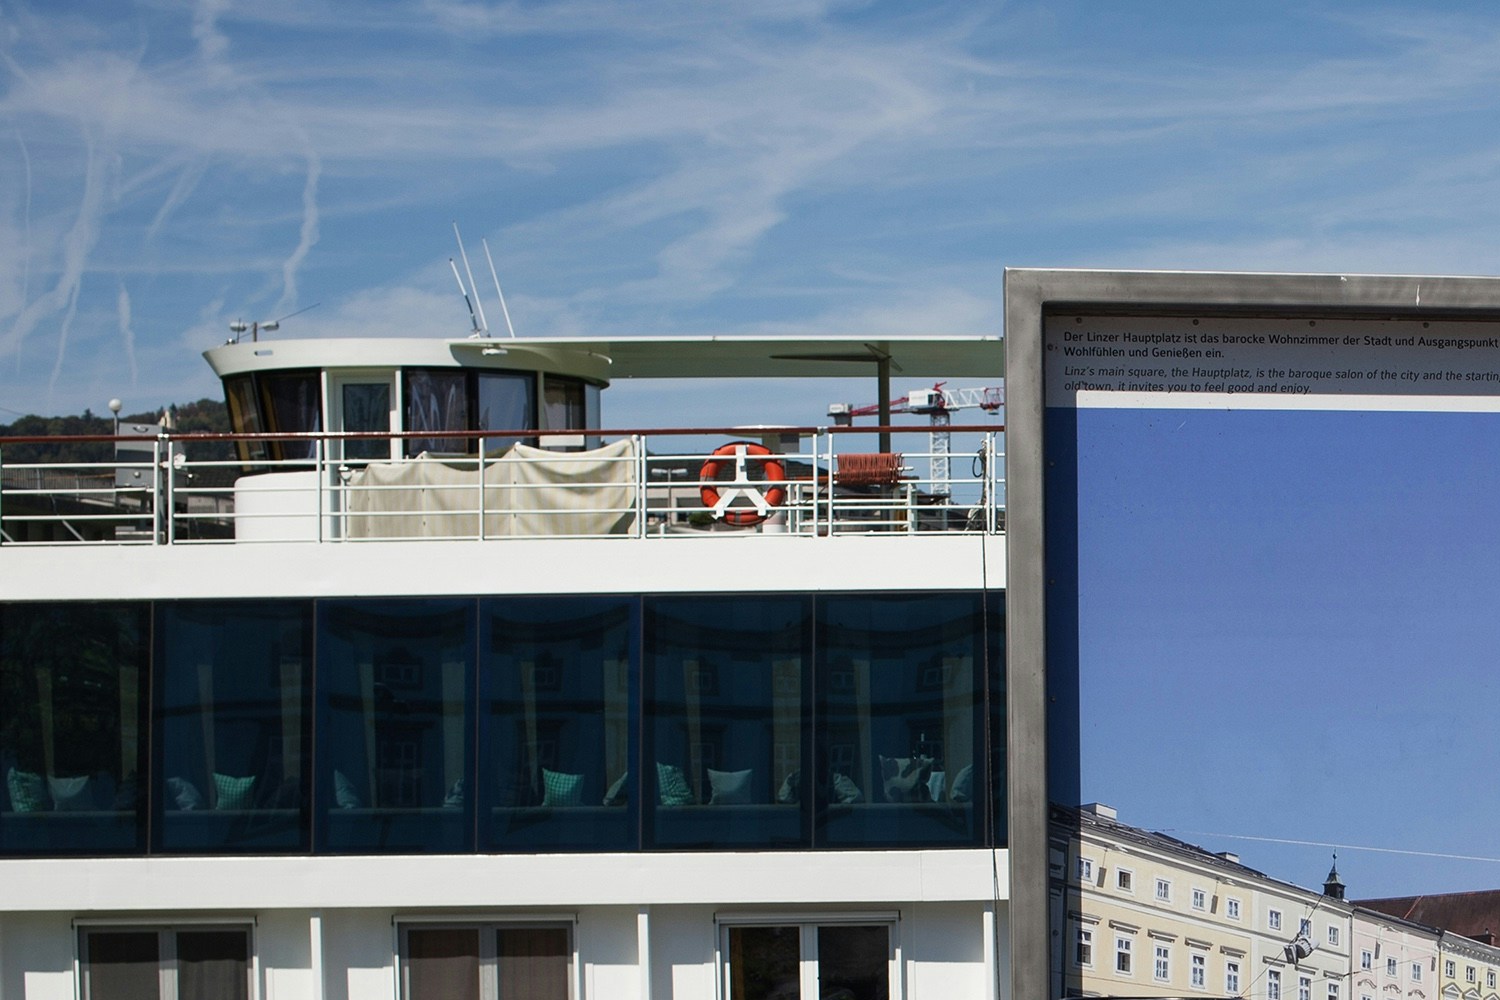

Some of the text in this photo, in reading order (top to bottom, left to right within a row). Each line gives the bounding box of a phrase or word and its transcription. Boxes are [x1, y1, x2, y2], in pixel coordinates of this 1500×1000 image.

[1063, 331, 1083, 342] Der
[1086, 332, 1120, 342] Linzer
[1123, 332, 1182, 345] Hauptplatz
[1184, 333, 1198, 344] ist
[1200, 333, 1219, 344] das
[1222, 334, 1266, 344] barocke
[1268, 335, 1339, 345] Wohnzimmer
[1342, 336, 1360, 346] der
[1363, 336, 1393, 347] Stadt
[1395, 337, 1414, 347] und
[1417, 337, 1499, 350] Ausgangspunkt
[1064, 347, 1225, 360] Wohlfühlen und Genießen ein.
[1098, 366, 1125, 377] main
[1127, 369, 1167, 379] square,
[1171, 367, 1189, 378] the
[1192, 368, 1252, 381] Hauptplatz,
[1255, 368, 1265, 379] is
[1268, 369, 1285, 379] the
[1288, 369, 1332, 382] baroque
[1335, 370, 1363, 380] salon
[1366, 370, 1378, 380] of
[1380, 370, 1397, 381] the
[1400, 371, 1420, 383] city
[1422, 371, 1443, 381] and
[1445, 371, 1463, 382] the
[1064, 381, 1312, 397] old town, it invites you to feel good and enjoy.
